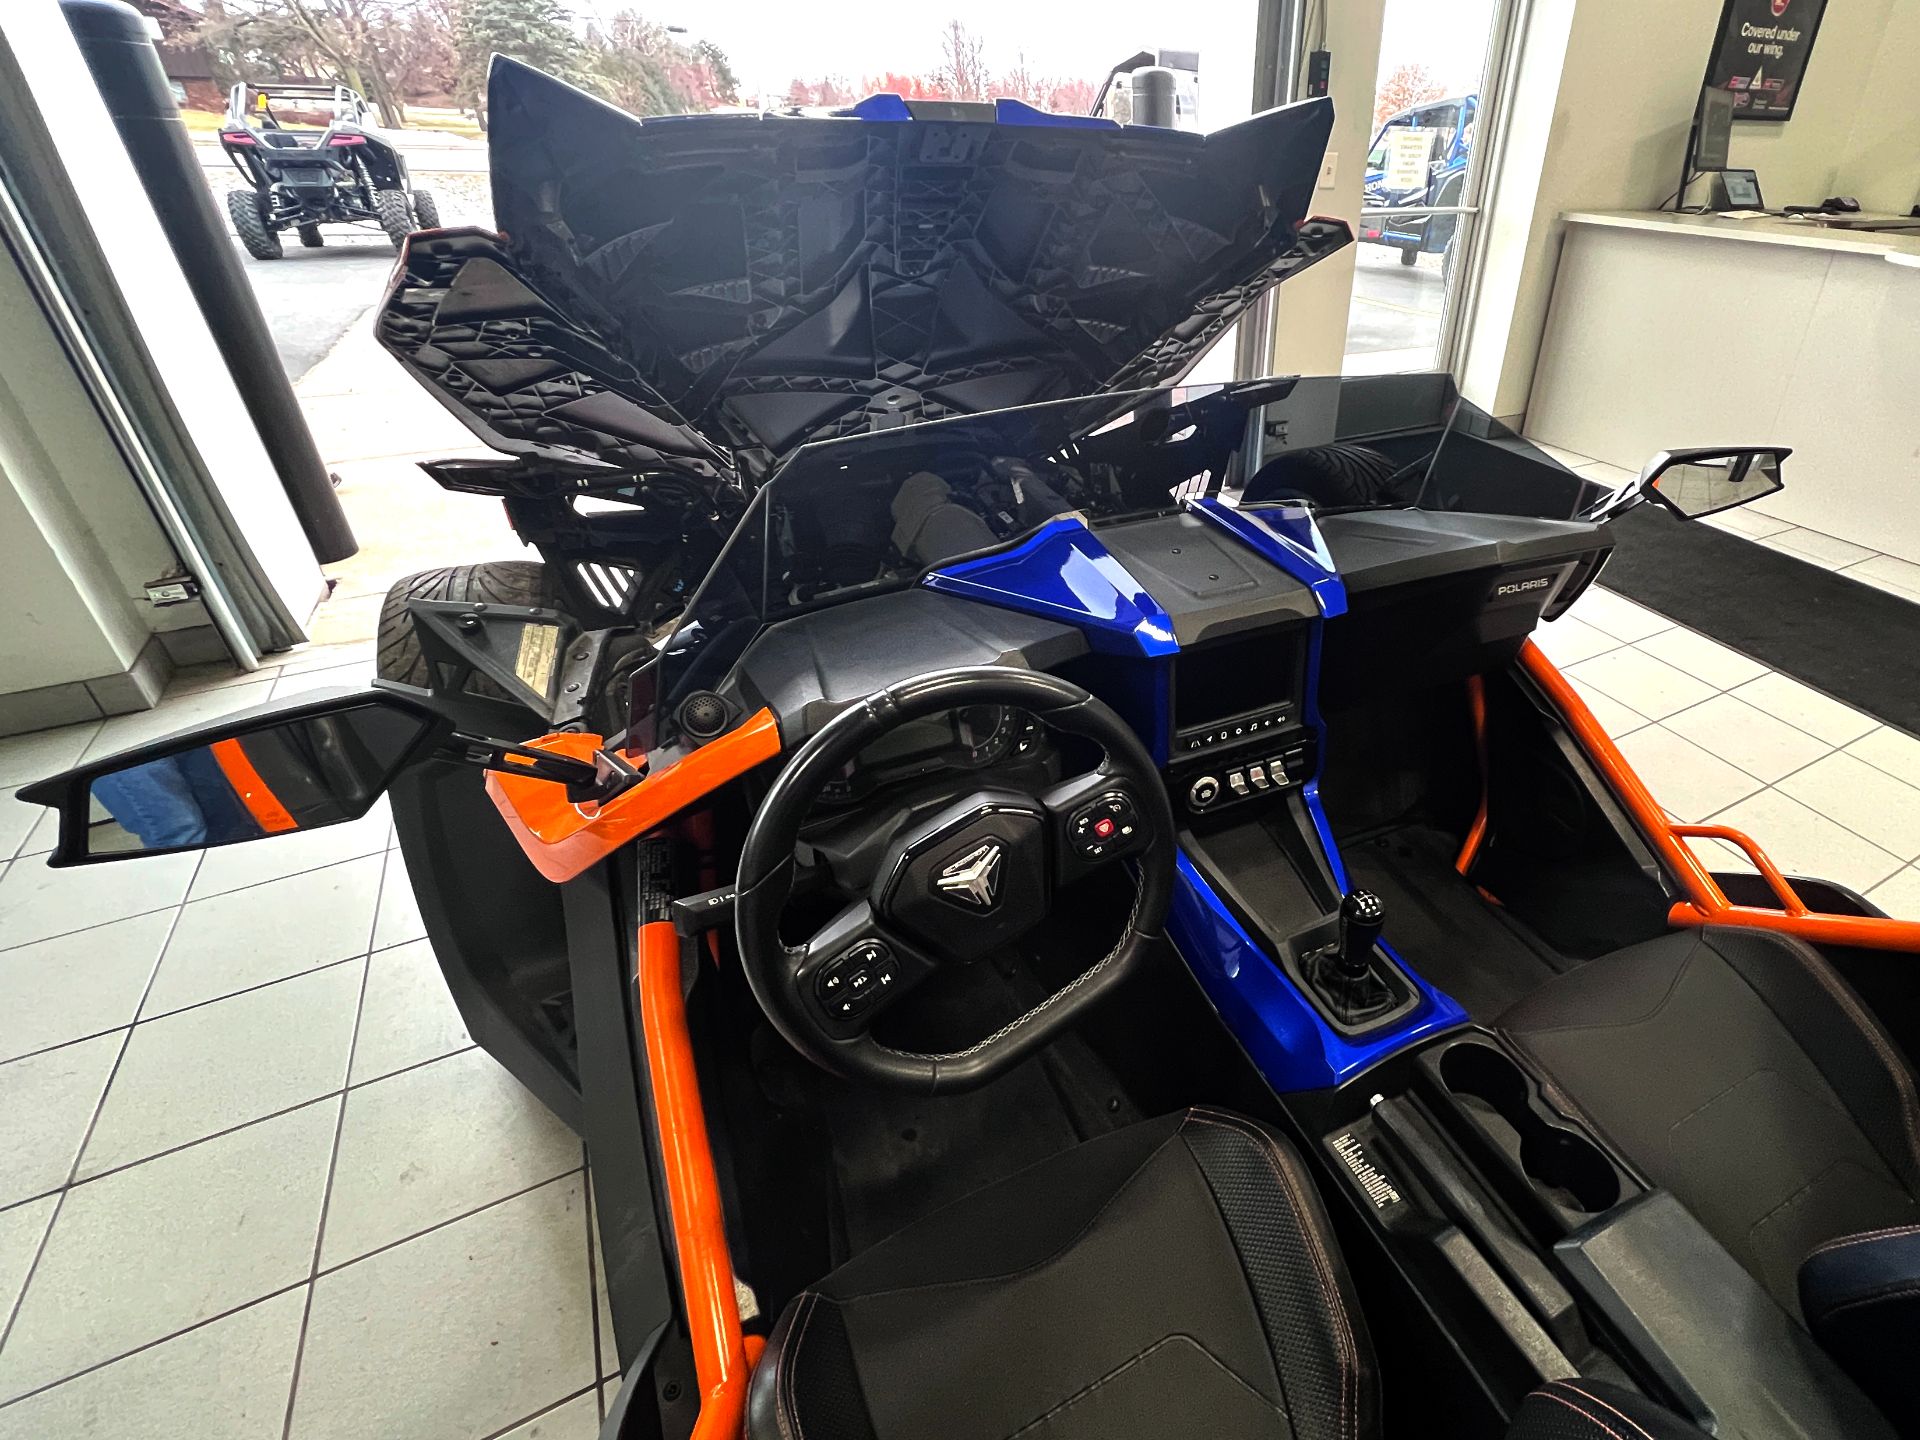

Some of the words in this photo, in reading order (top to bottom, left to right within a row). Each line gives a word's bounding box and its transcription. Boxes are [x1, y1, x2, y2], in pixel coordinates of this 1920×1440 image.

[1741, 22, 1778, 39] Covered
[1776, 27, 1801, 42] under
[1747, 42, 1764, 54] our
[1497, 577, 1549, 596] POLARIS
